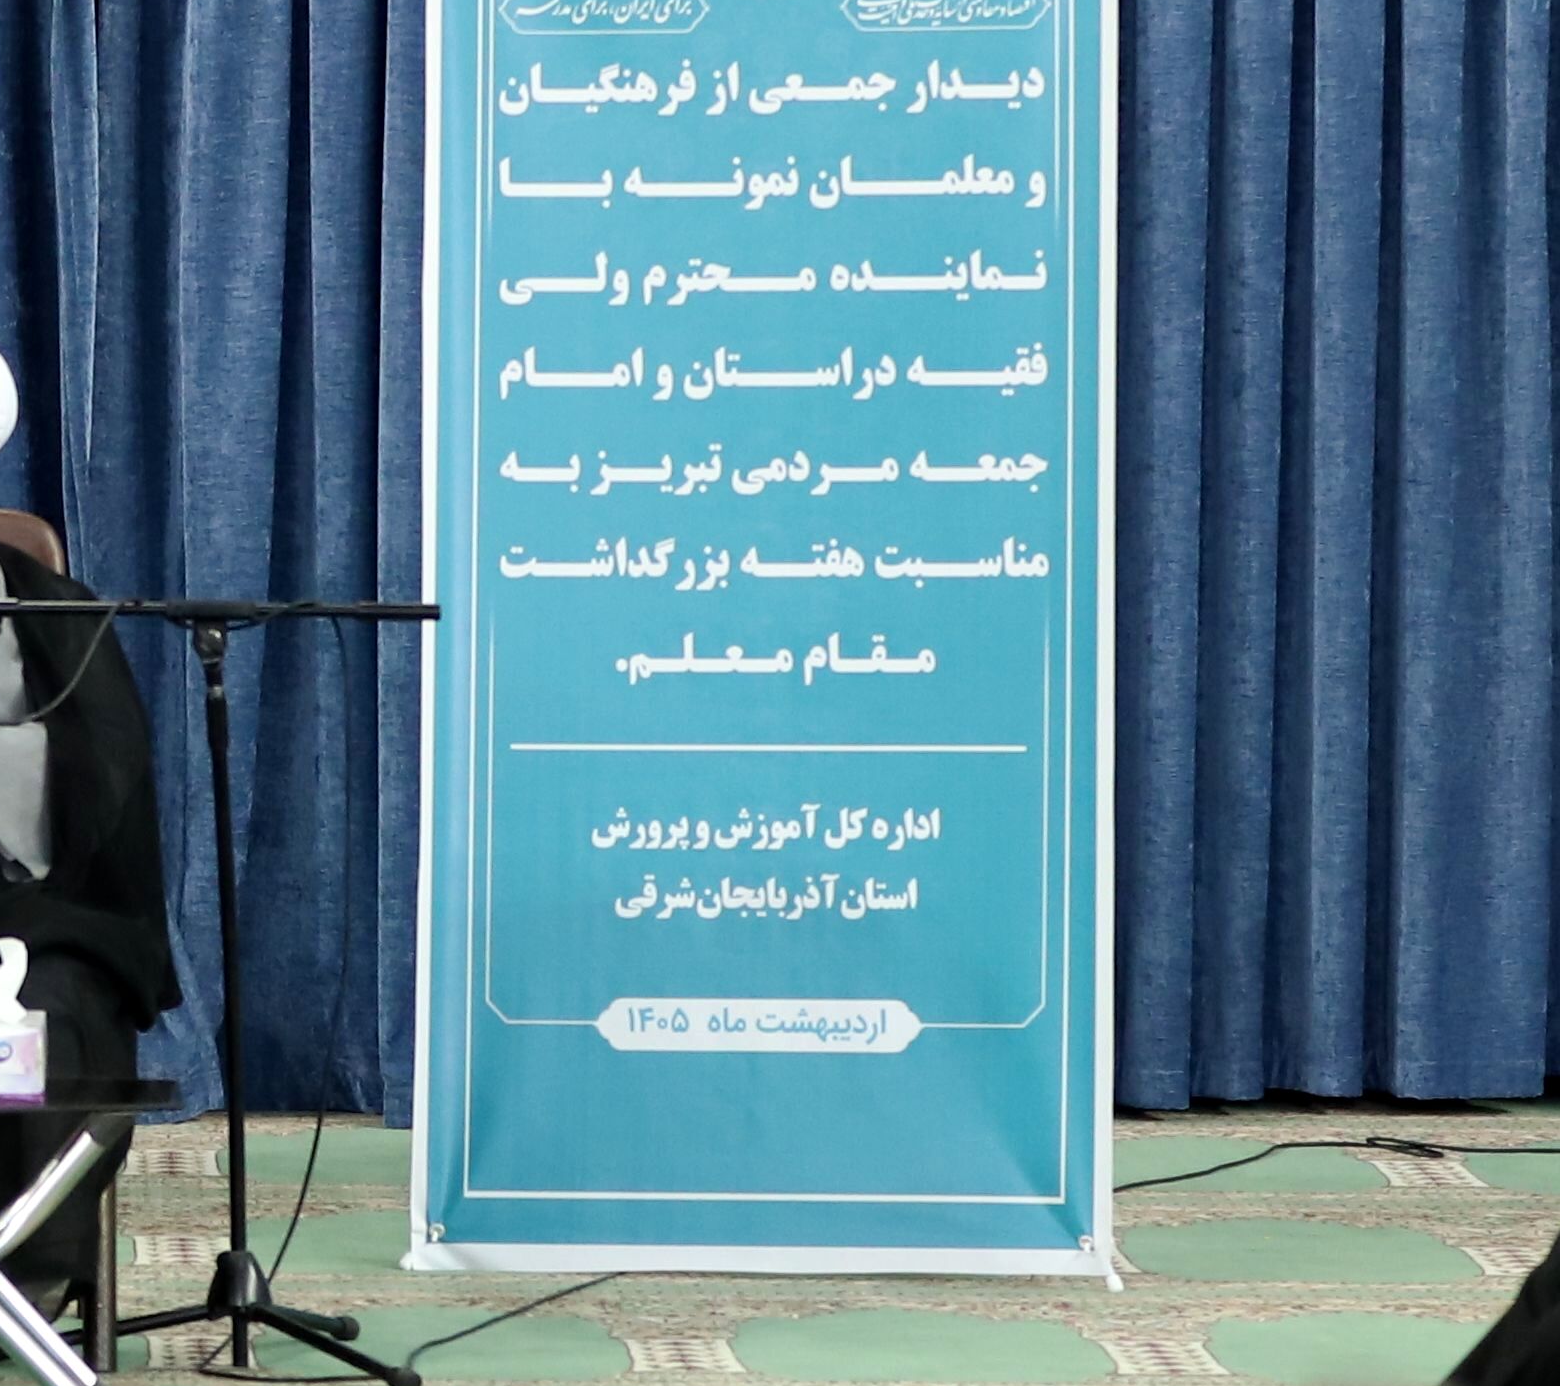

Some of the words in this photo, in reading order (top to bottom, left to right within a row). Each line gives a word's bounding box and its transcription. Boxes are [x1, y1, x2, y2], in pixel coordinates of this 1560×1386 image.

[498, 59, 697, 116] فرهنگیان
[707, 61, 740, 116] از
[749, 72, 897, 115] جمعی
[907, 60, 1045, 114] دیدار
[498, 157, 614, 208] با
[623, 156, 799, 210] نمونه
[809, 154, 1015, 209] معلمان
[1026, 171, 1047, 208] و
[499, 251, 630, 306] ولی
[642, 258, 817, 306] محترم
[829, 249, 1047, 301] نماینده
[499, 346, 644, 400] امام
[652, 364, 674, 401] و
[683, 346, 853, 400] استان
[853, 355, 897, 400] در
[906, 342, 1048, 396] فقیه
[499, 451, 581, 493] به
[590, 443, 722, 496] تبریز
[731, 450, 900, 496] مردمی
[909, 451, 1048, 493] جمعه
[499, 537, 730, 591] بزرگداشت
[740, 538, 865, 578] هفته
[874, 537, 1050, 588] مناسبت
[803, 632, 936, 686] مقام
[591, 807, 690, 850] پرورش
[692, 820, 710, 850] و
[714, 803, 821, 850] آموزش
[824, 807, 868, 849] کل
[871, 808, 940, 851] اداره
[841, 878, 918, 919] استان
[627, 1006, 690, 1034] ۱۴۰۵
[707, 1007, 747, 1033] ماه
[755, 1008, 887, 1045] اردیبهشت
